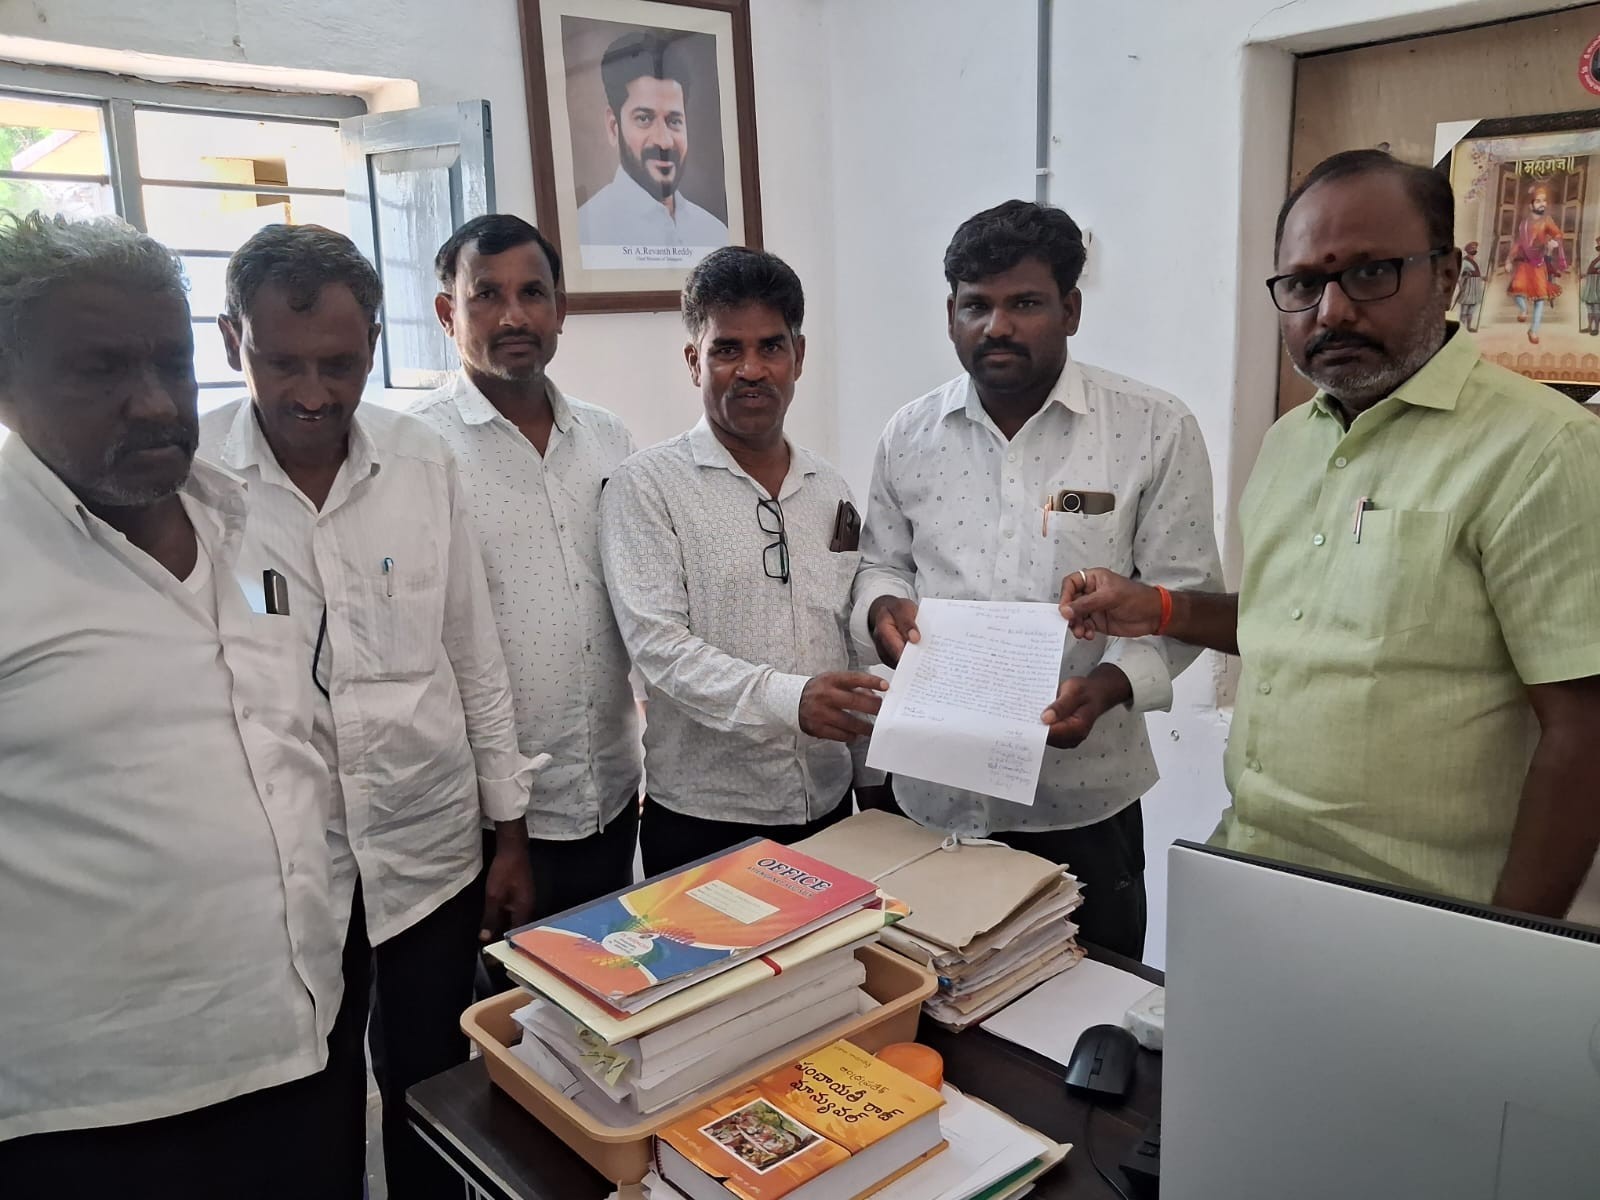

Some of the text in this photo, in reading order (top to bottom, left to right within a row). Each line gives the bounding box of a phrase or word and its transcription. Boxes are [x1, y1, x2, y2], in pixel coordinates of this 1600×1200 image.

[622, 246, 633, 255] Sri
[672, 247, 693, 256] Reddy
[757, 858, 831, 891] OFFICE
